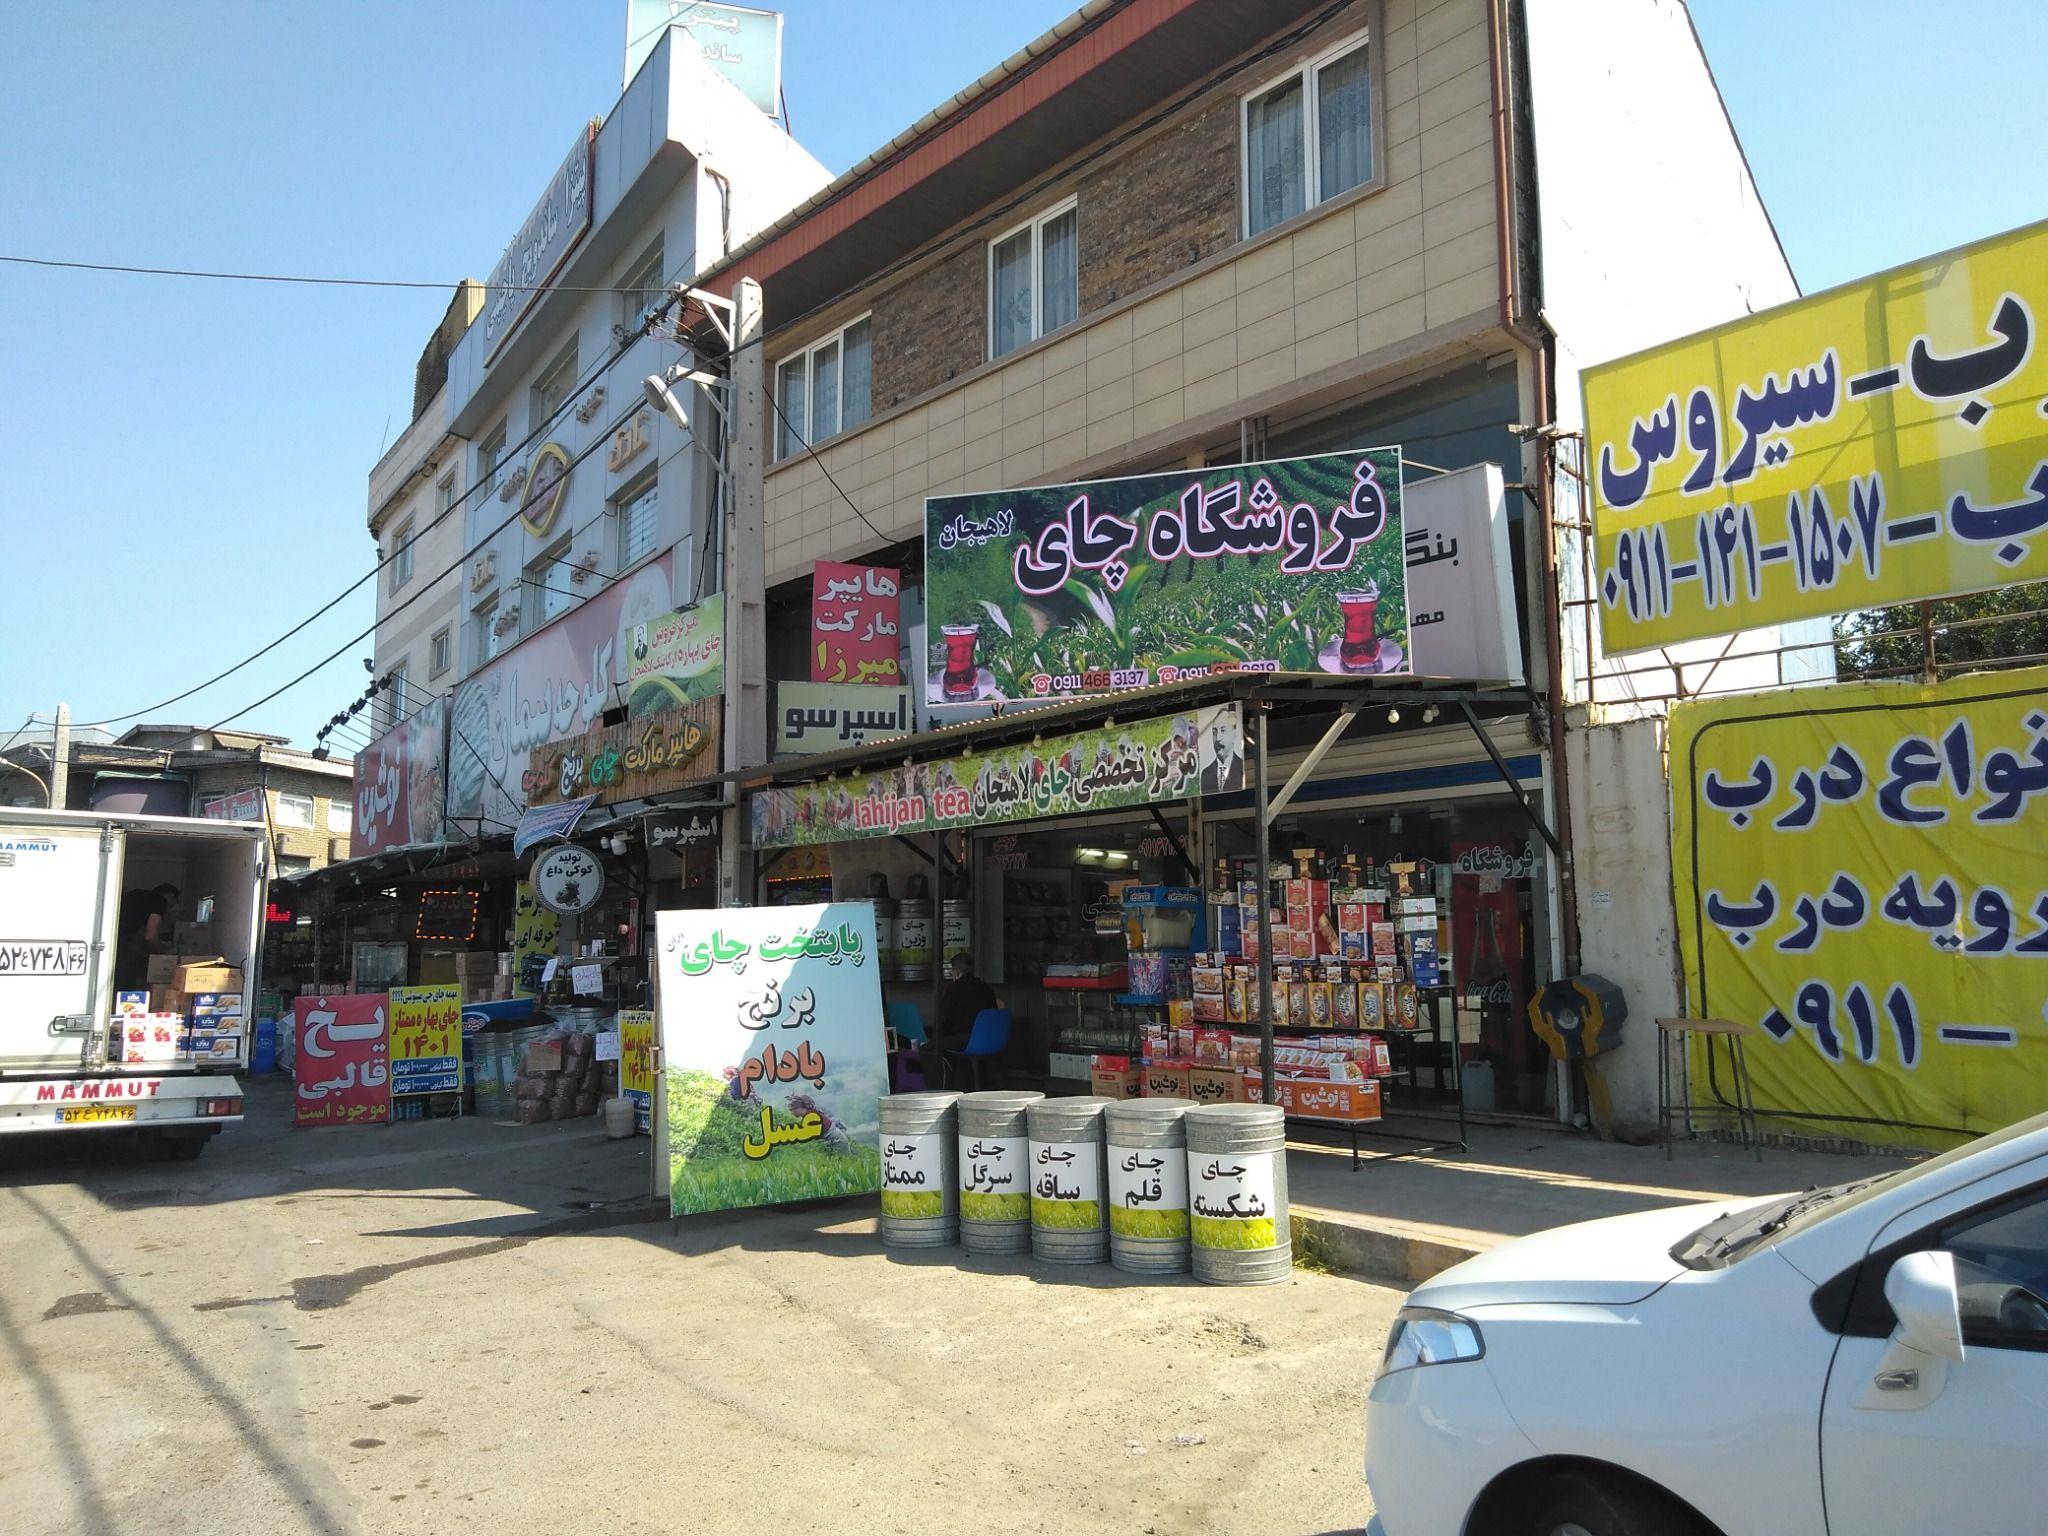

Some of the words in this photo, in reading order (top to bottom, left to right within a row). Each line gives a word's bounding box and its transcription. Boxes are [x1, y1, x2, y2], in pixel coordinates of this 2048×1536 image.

[702, 42, 743, 64] ساند
[937, 509, 1015, 550] لاهیجان
[1148, 460, 1387, 574] فروشگاه
[1013, 493, 1139, 595] چای
[817, 568, 899, 604] هایپر
[815, 609, 898, 642] مارکت
[816, 640, 899, 684] میرزا
[785, 693, 907, 747] اسپرسو
[624, 721, 665, 775] مارکت
[665, 720, 702, 767] هایپر
[559, 748, 584, 798] برنج
[589, 744, 621, 786] چای
[1070, 745, 1148, 807] تخصصی
[1149, 740, 1199, 797] مرکز
[972, 759, 1034, 820] لاهیجان
[1031, 755, 1074, 813] چای
[1705, 746, 1864, 827] درب
[853, 793, 925, 832] lahijan
[932, 786, 972, 819] tea
[652, 816, 719, 847] اسپرسو
[545, 866, 563, 878] داغ
[558, 852, 582, 864] تولید
[566, 864, 594, 878] کوکی
[1457, 841, 1536, 878] فروشگاه
[902, 920, 926, 931] چای
[1706, 874, 1866, 950] درب
[680, 929, 752, 977] چای
[759, 921, 864, 968] پایتخت
[439, 1003, 460, 1032] چای
[737, 978, 817, 1031] برنج
[303, 997, 387, 1059] یخ
[403, 1033, 449, 1058] ۱۴۰۱
[298, 1057, 389, 1101] قالبی
[392, 1061, 411, 1076] تومان
[442, 1057, 457, 1071] فقط
[739, 1039, 826, 1099] بادام
[37, 1081, 161, 1101] MAMMUT
[393, 1078, 412, 1093] تومان
[443, 1074, 459, 1089] فقط
[1149, 1075, 1179, 1094] نوشین
[1193, 1078, 1226, 1099] نوشین
[297, 1101, 332, 1121] است
[336, 1101, 387, 1120] موجود
[1300, 1088, 1339, 1110] نوشین
[742, 1104, 824, 1161] عسل
[882, 1138, 918, 1159] چای
[967, 1139, 1007, 1161] چای
[1036, 1150, 1077, 1168] چای
[1120, 1151, 1166, 1175] چای
[882, 1160, 926, 1188] ممتاز
[963, 1163, 1014, 1194] سرگل
[1036, 1174, 1082, 1201] ساقه
[1201, 1159, 1248, 1184] چای
[1125, 1177, 1164, 1210] قلم
[1192, 1191, 1267, 1218] شکسته
